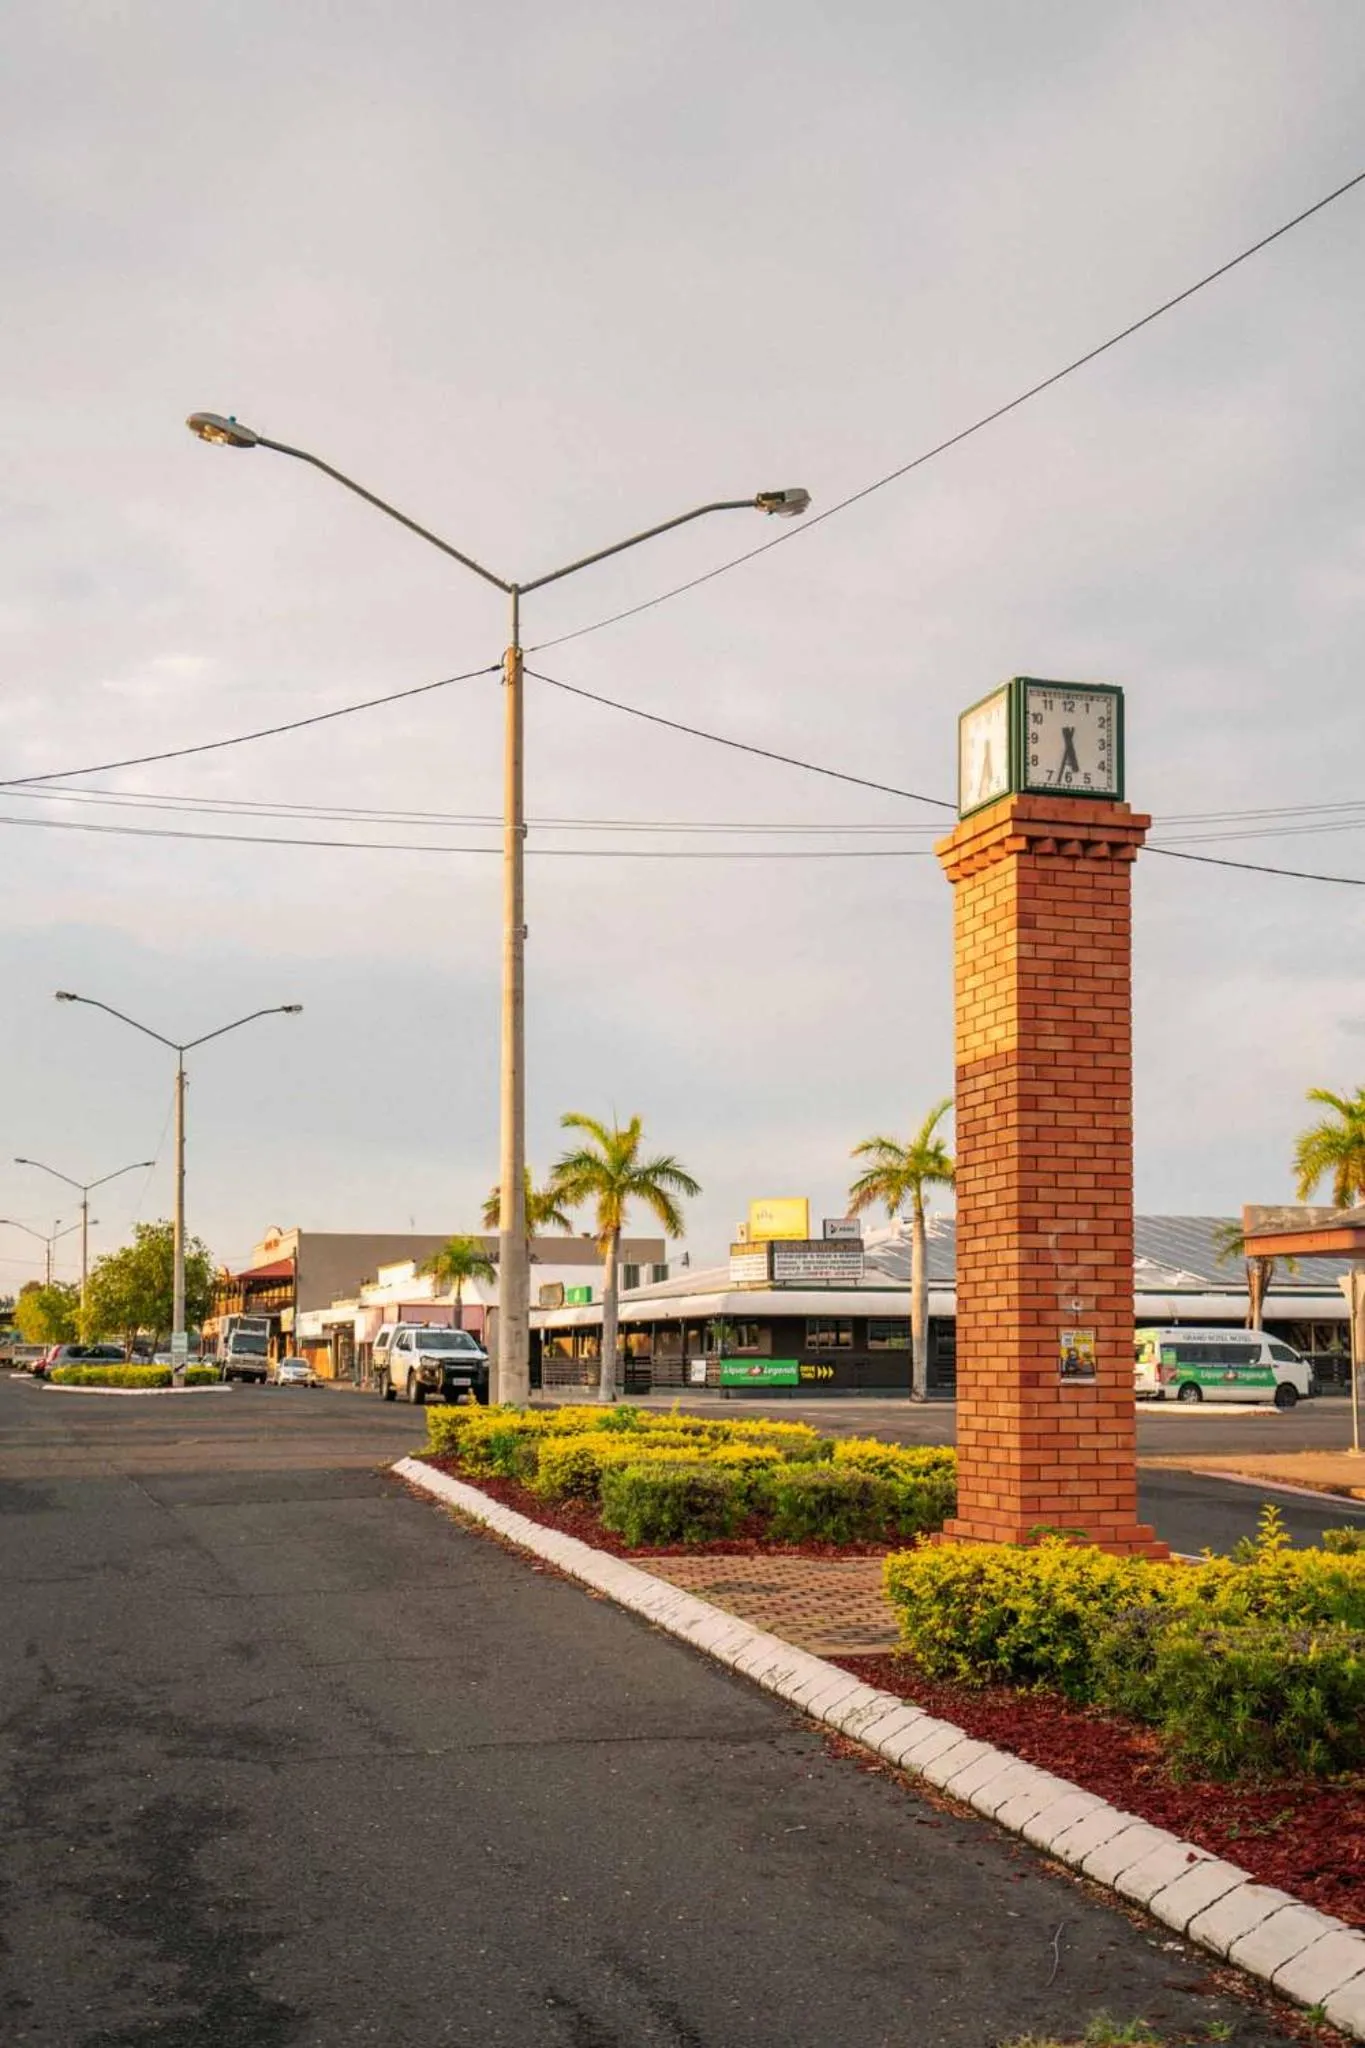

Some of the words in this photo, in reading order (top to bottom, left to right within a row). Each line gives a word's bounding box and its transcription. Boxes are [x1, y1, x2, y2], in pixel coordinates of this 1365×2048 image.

[1043, 699, 1053, 711] 11
[1063, 701, 1075, 713] 12
[1031, 712, 1043, 725] 10
[1098, 716, 1106, 728] 2
[1030, 732, 1038, 744] 9
[1098, 738, 1106, 751] 3
[1031, 755, 1038, 767] 8
[1098, 761, 1106, 773] 4
[1046, 769, 1054, 781] 7
[1065, 771, 1073, 783] 6
[1084, 773, 1092, 785] 5
